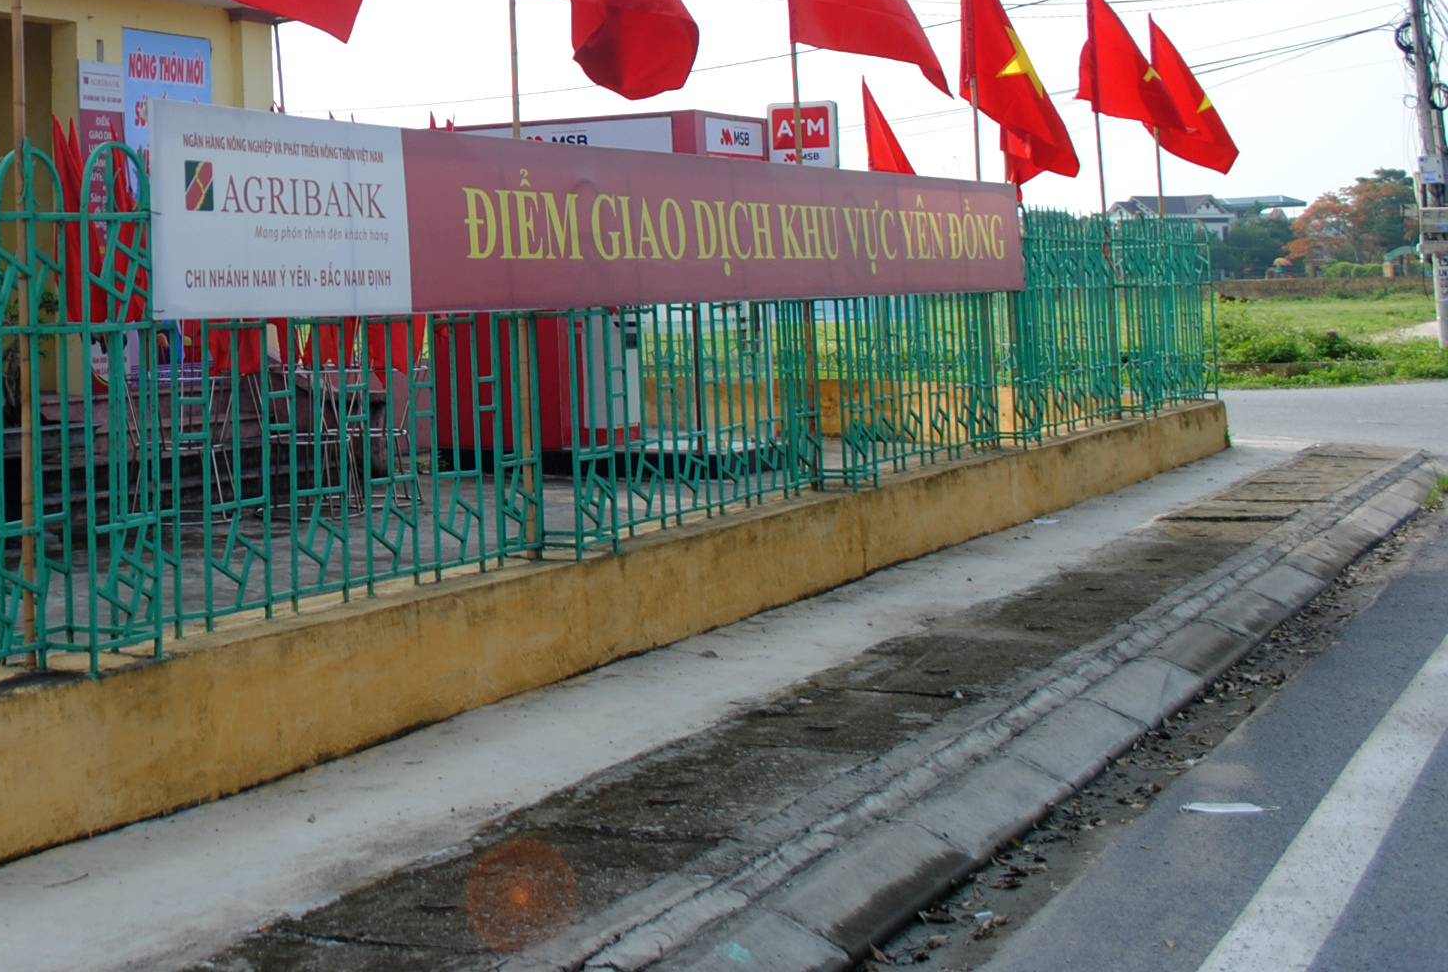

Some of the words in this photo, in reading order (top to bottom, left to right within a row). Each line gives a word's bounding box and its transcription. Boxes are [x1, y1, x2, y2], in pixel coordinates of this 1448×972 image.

[128, 47, 157, 81] NÔNG
[159, 51, 185, 84] THÔN
[186, 52, 204, 86] MỚI
[183, 132, 204, 148] NGÂN
[205, 133, 225, 150] HÀNG
[226, 135, 247, 152] NÔNG
[273, 138, 283, 155] VÀ
[283, 140, 300, 157] PHÁT
[370, 149, 384, 163] NAM
[733, 130, 750, 147] MSB
[220, 174, 387, 219] AGRIBANK
[254, 225, 279, 242] Mang
[344, 227, 367, 241] khách
[462, 168, 584, 260] ĐIỂM
[591, 193, 686, 261] GIAO
[690, 199, 776, 277] DỊCH
[777, 203, 839, 261] KHU
[842, 200, 897, 275] VỰC
[898, 194, 946, 260] YÊN
[947, 198, 1006, 261] ĐỒNG
[185, 269, 206, 289] CHI
[209, 264, 250, 289] NHÁNH
[253, 269, 277, 288] NAM
[279, 264, 287, 288] Ý
[289, 265, 311, 287] YÊN
[320, 261, 341, 287] BẮC
[344, 269, 366, 287] NAM
[368, 269, 392, 290] ĐỊNH
